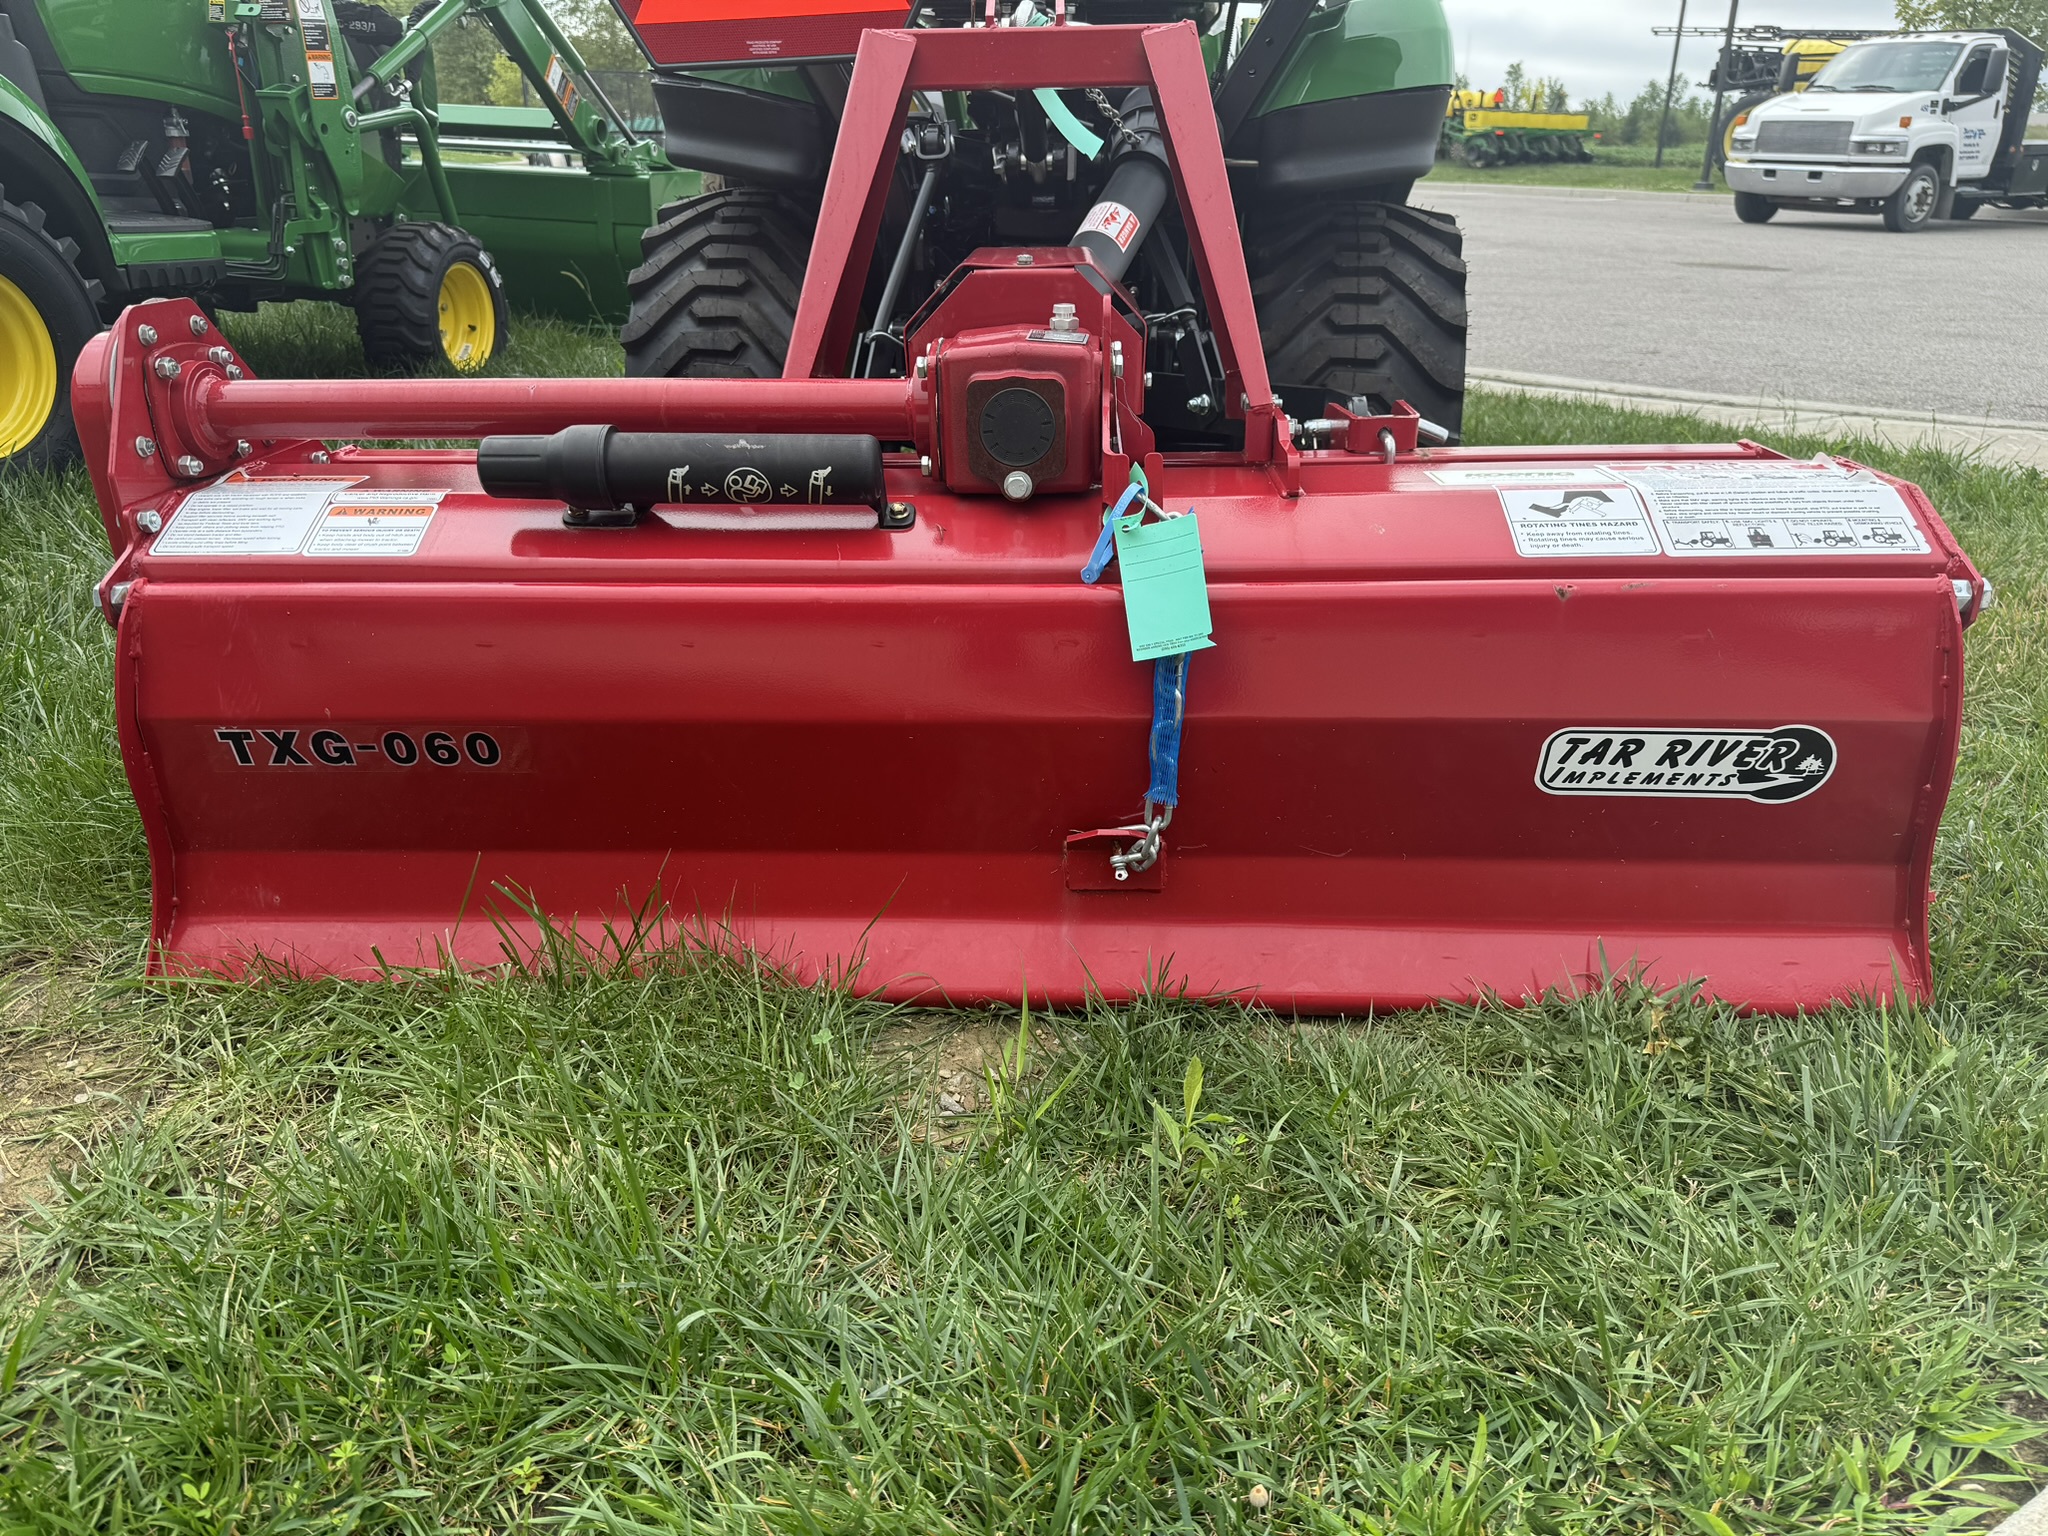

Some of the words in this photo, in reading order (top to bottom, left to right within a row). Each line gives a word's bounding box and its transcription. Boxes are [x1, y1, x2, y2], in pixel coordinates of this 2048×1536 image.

[214, 729, 502, 767] TXG-060
[1556, 737, 1646, 769] TAR
[1654, 738, 1800, 773] RIVER
[1546, 767, 1740, 787] IMPLEMENTS
